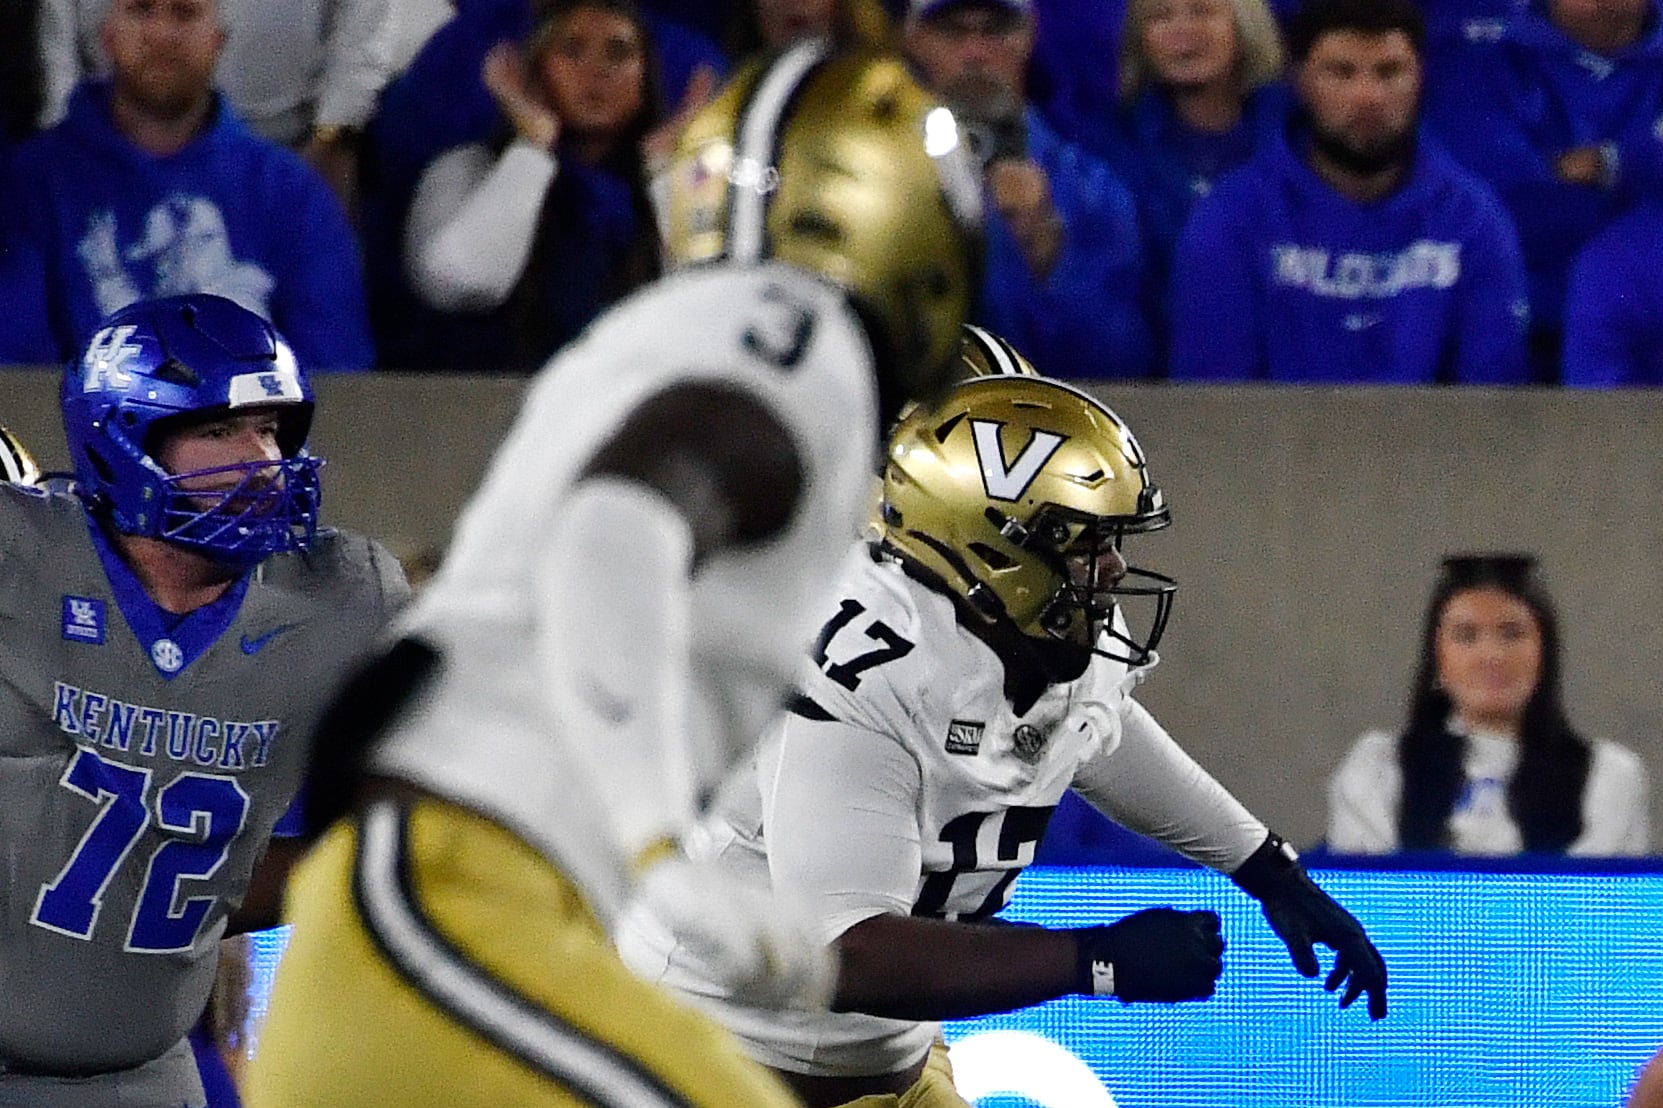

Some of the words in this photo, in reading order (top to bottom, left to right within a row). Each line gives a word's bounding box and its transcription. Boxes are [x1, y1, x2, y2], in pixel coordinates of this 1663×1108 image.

[968, 417, 1071, 502] V
[812, 598, 916, 692] 17
[52, 681, 280, 769] KENTUCKY
[28, 743, 251, 955] 72
